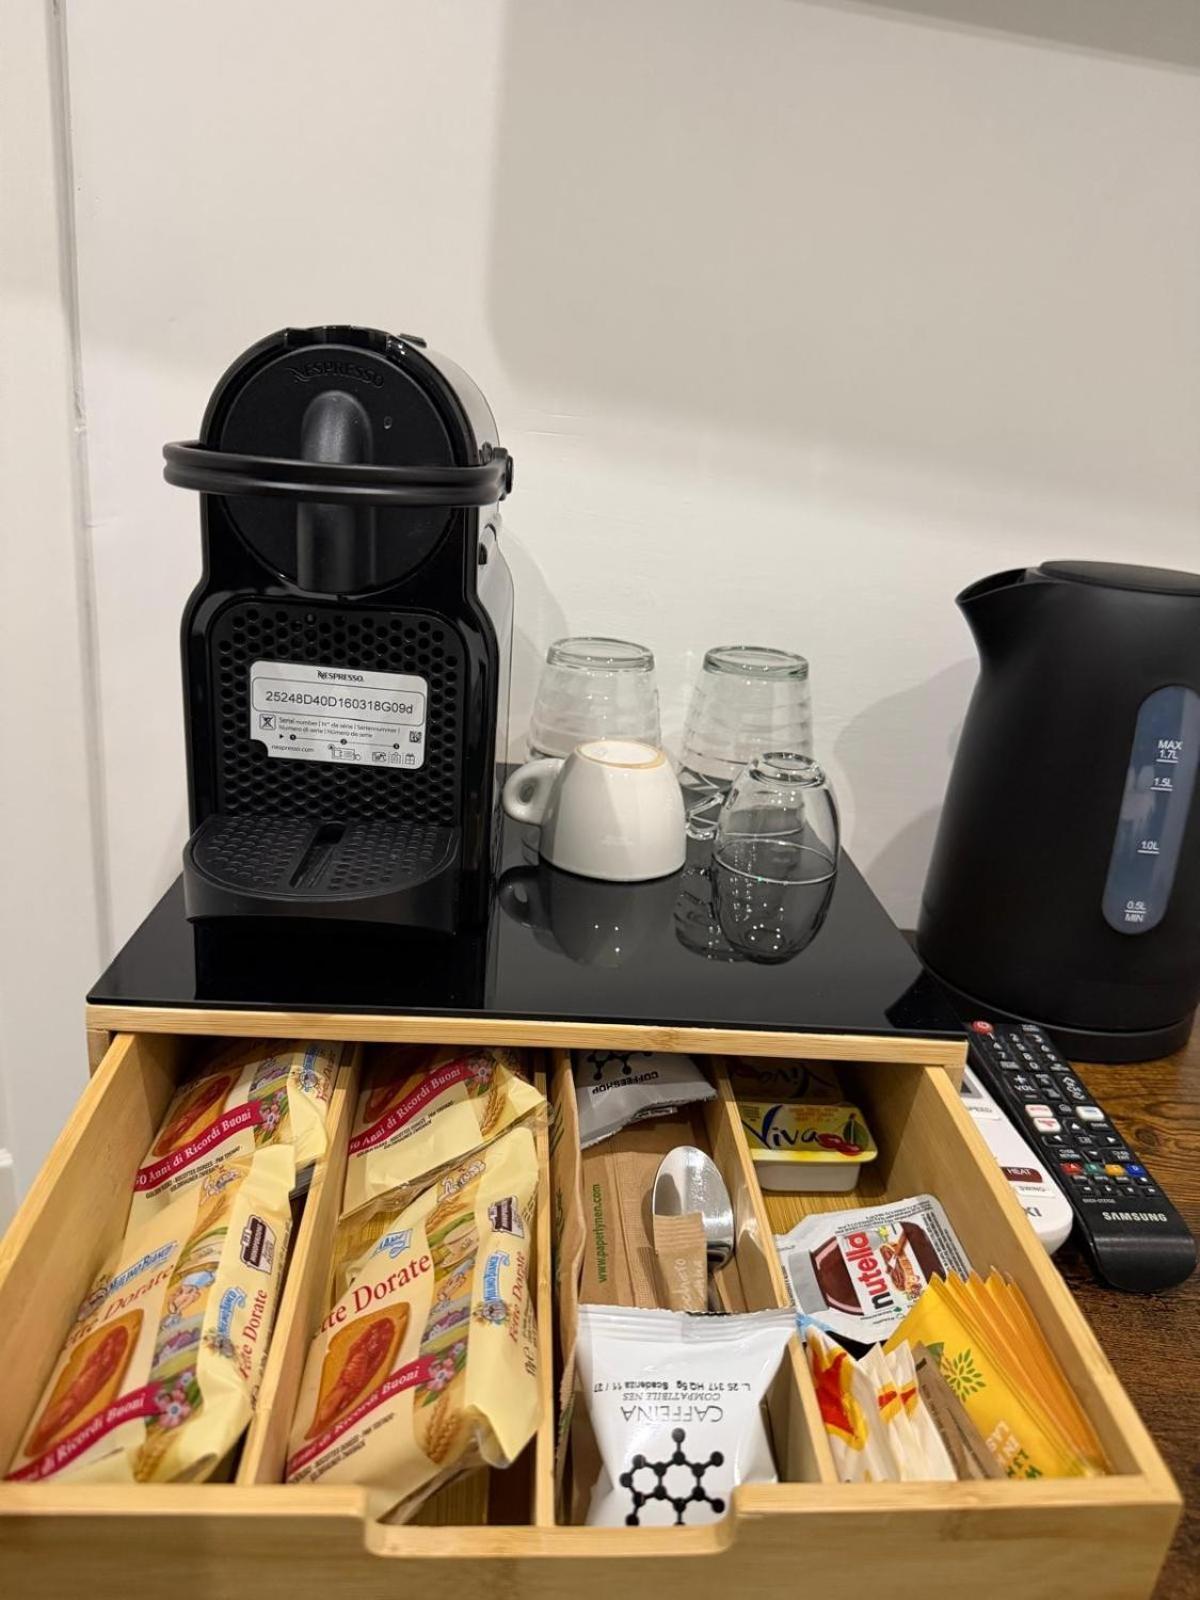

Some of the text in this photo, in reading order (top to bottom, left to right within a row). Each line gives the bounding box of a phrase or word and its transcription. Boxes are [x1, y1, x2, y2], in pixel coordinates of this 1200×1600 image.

[286, 360, 385, 389] NESPRESSO
[316, 670, 364, 682] NESPRESSO
[1157, 740, 1183, 751] MAX
[1159, 750, 1178, 760] 1.7L
[1153, 778, 1173, 788] 1.5L
[1141, 841, 1160, 851] 1.0L
[1126, 901, 1146, 911] 0.5L
[1124, 913, 1144, 923] MIN
[1014, 1084, 1036, 1092] VOL
[386, 1116, 397, 1129] di
[396, 1086, 430, 1119] Ricordi
[430, 1067, 461, 1091] Buoni
[741, 1104, 821, 1151] Viva
[148, 1162, 172, 1182] Anni
[173, 1154, 184, 1167] di
[184, 1128, 220, 1159] Ricordi
[222, 1110, 251, 1132] Buoni
[1006, 1168, 1031, 1176] HEAT
[1102, 1211, 1168, 1223] SAMSUNG
[844, 1231, 894, 1310] nutella
[352, 1254, 432, 1314] Dorate
[242, 1289, 269, 1343] Dorate
[381, 1366, 420, 1395] Buoni
[624, 1381, 669, 1390] Scadenza
[622, 1392, 643, 1401] NES
[620, 1405, 724, 1423] CAFFEINA
[57, 1414, 103, 1463] Ricordi
[105, 1392, 146, 1423] Buoni
